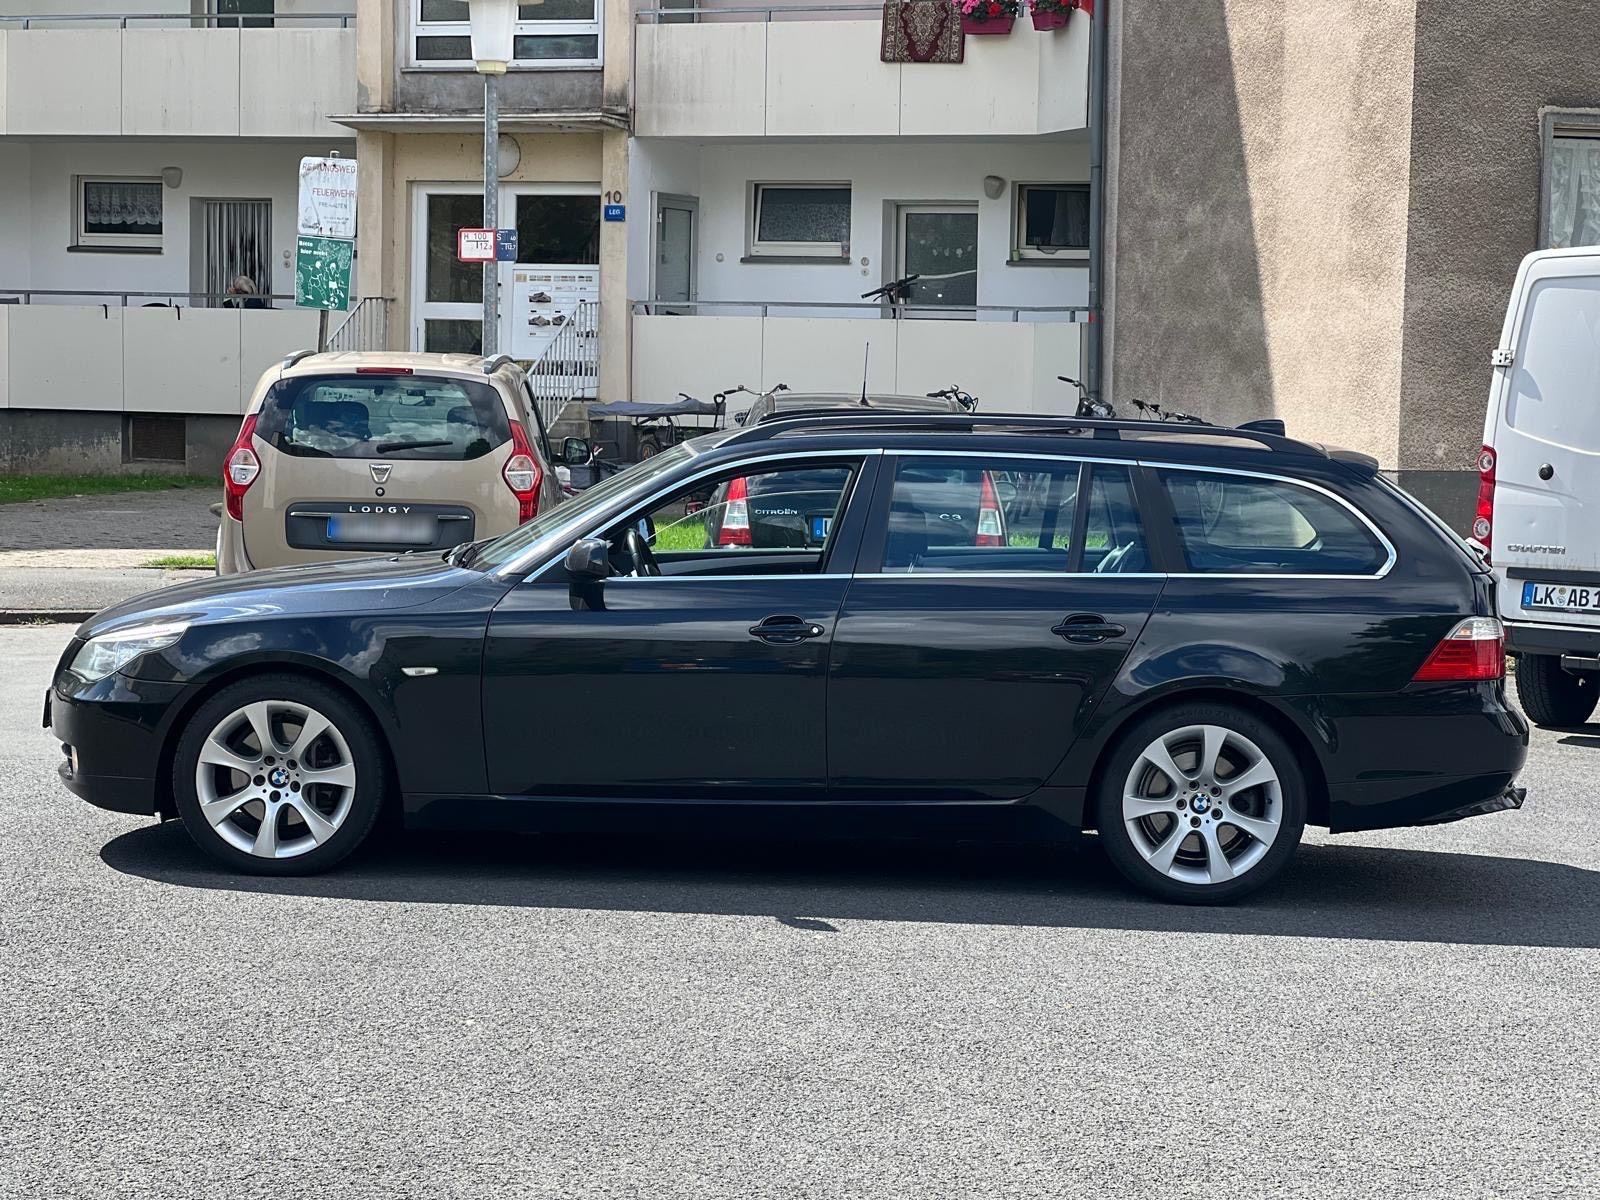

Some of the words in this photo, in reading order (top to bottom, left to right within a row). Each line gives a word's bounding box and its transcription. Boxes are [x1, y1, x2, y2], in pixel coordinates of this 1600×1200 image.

[312, 187, 356, 198] FEUERWEHR
[605, 190, 622, 205] 10
[318, 201, 348, 209] FREALTEN
[496, 233, 502, 241] S
[348, 505, 412, 514] LODGY
[939, 513, 962, 522] C3
[1507, 543, 1566, 555] CRAFTER
[1532, 586, 1557, 605] LK
[1567, 588, 1590, 607] AB
